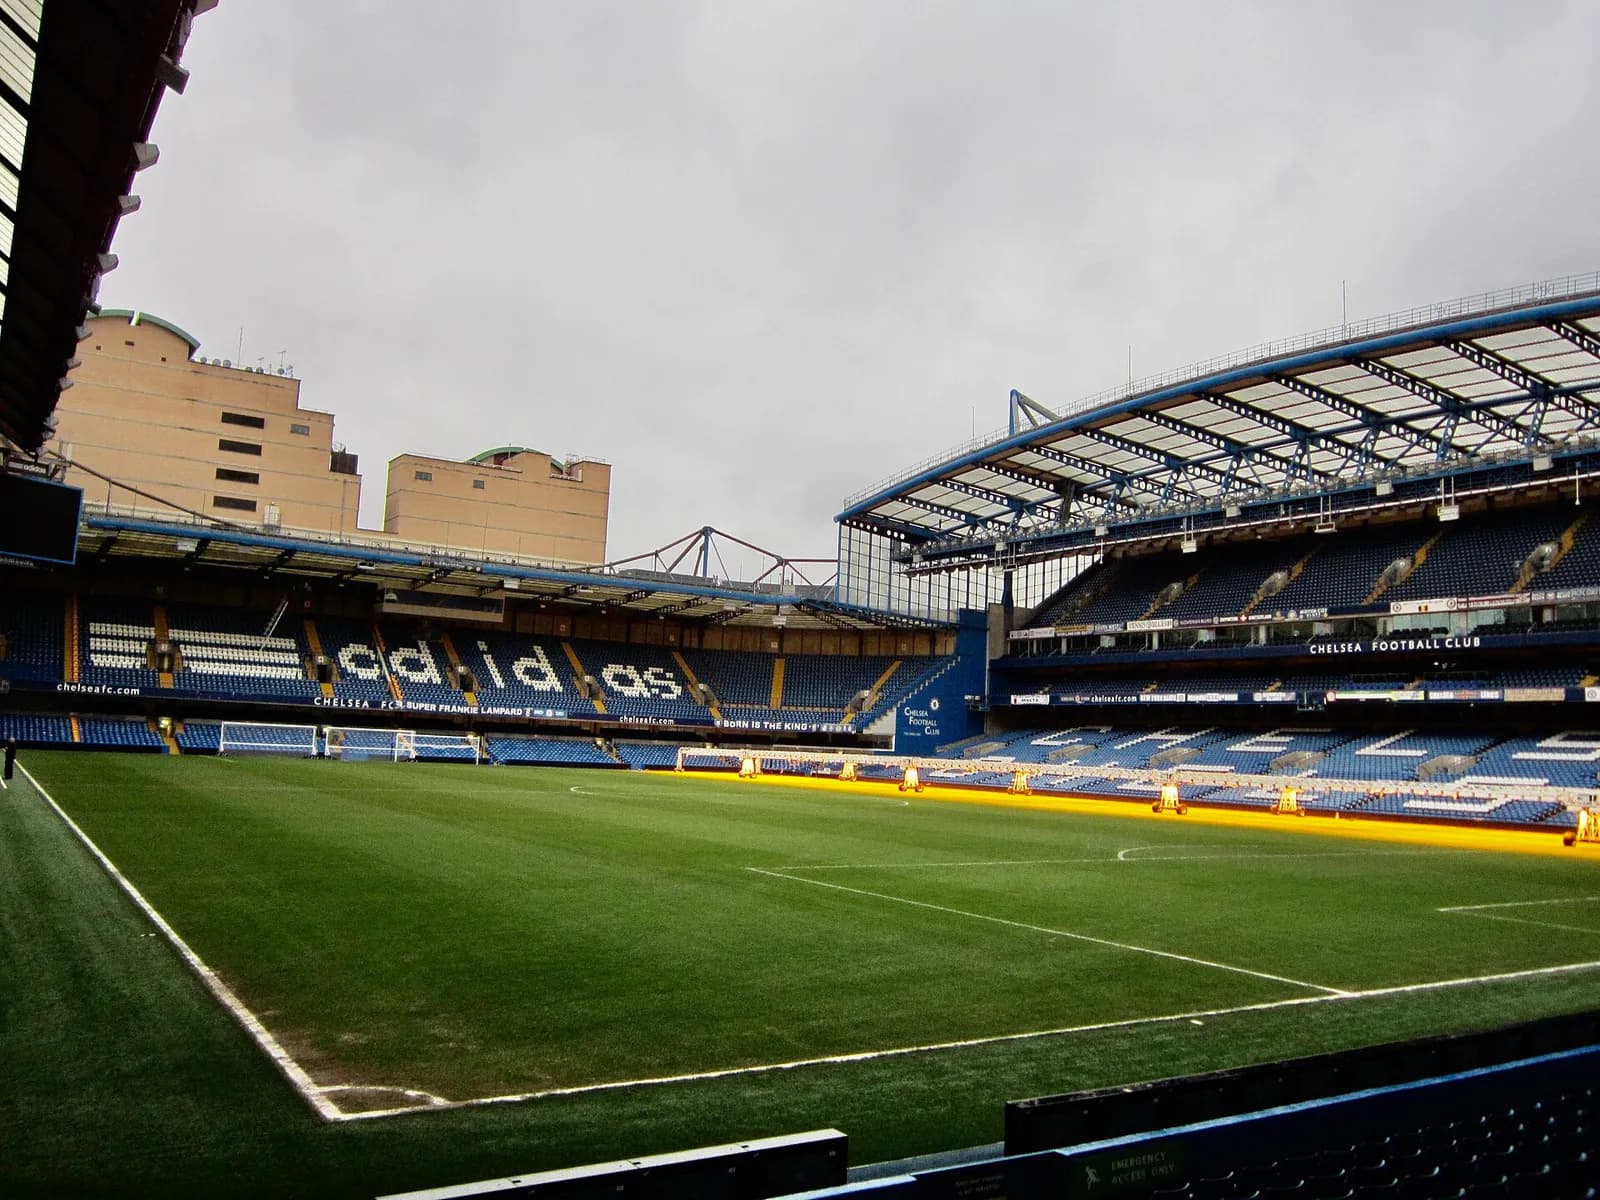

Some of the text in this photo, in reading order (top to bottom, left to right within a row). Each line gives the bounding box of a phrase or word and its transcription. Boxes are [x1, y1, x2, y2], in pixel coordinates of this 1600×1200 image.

[1309, 636, 1481, 655] CHELSEA FOOTBALL CLUB
[57, 682, 140, 696] chelseafc.com
[313, 697, 370, 708] CHELSEA
[1091, 693, 1138, 704] chelseafc.com
[406, 701, 436, 712] SUPER
[438, 704, 479, 715] FRANKIE
[481, 706, 523, 717] LAMPARD
[904, 706, 929, 717] CHELSEA
[619, 715, 675, 725] chelseafc.com
[723, 719, 749, 729] BORN
[751, 720, 761, 730] IS
[763, 721, 782, 731] THE
[784, 722, 808, 732] KING
[909, 715, 938, 727] FOOTBALL
[1111, 1151, 1167, 1171] EMERGENCY
